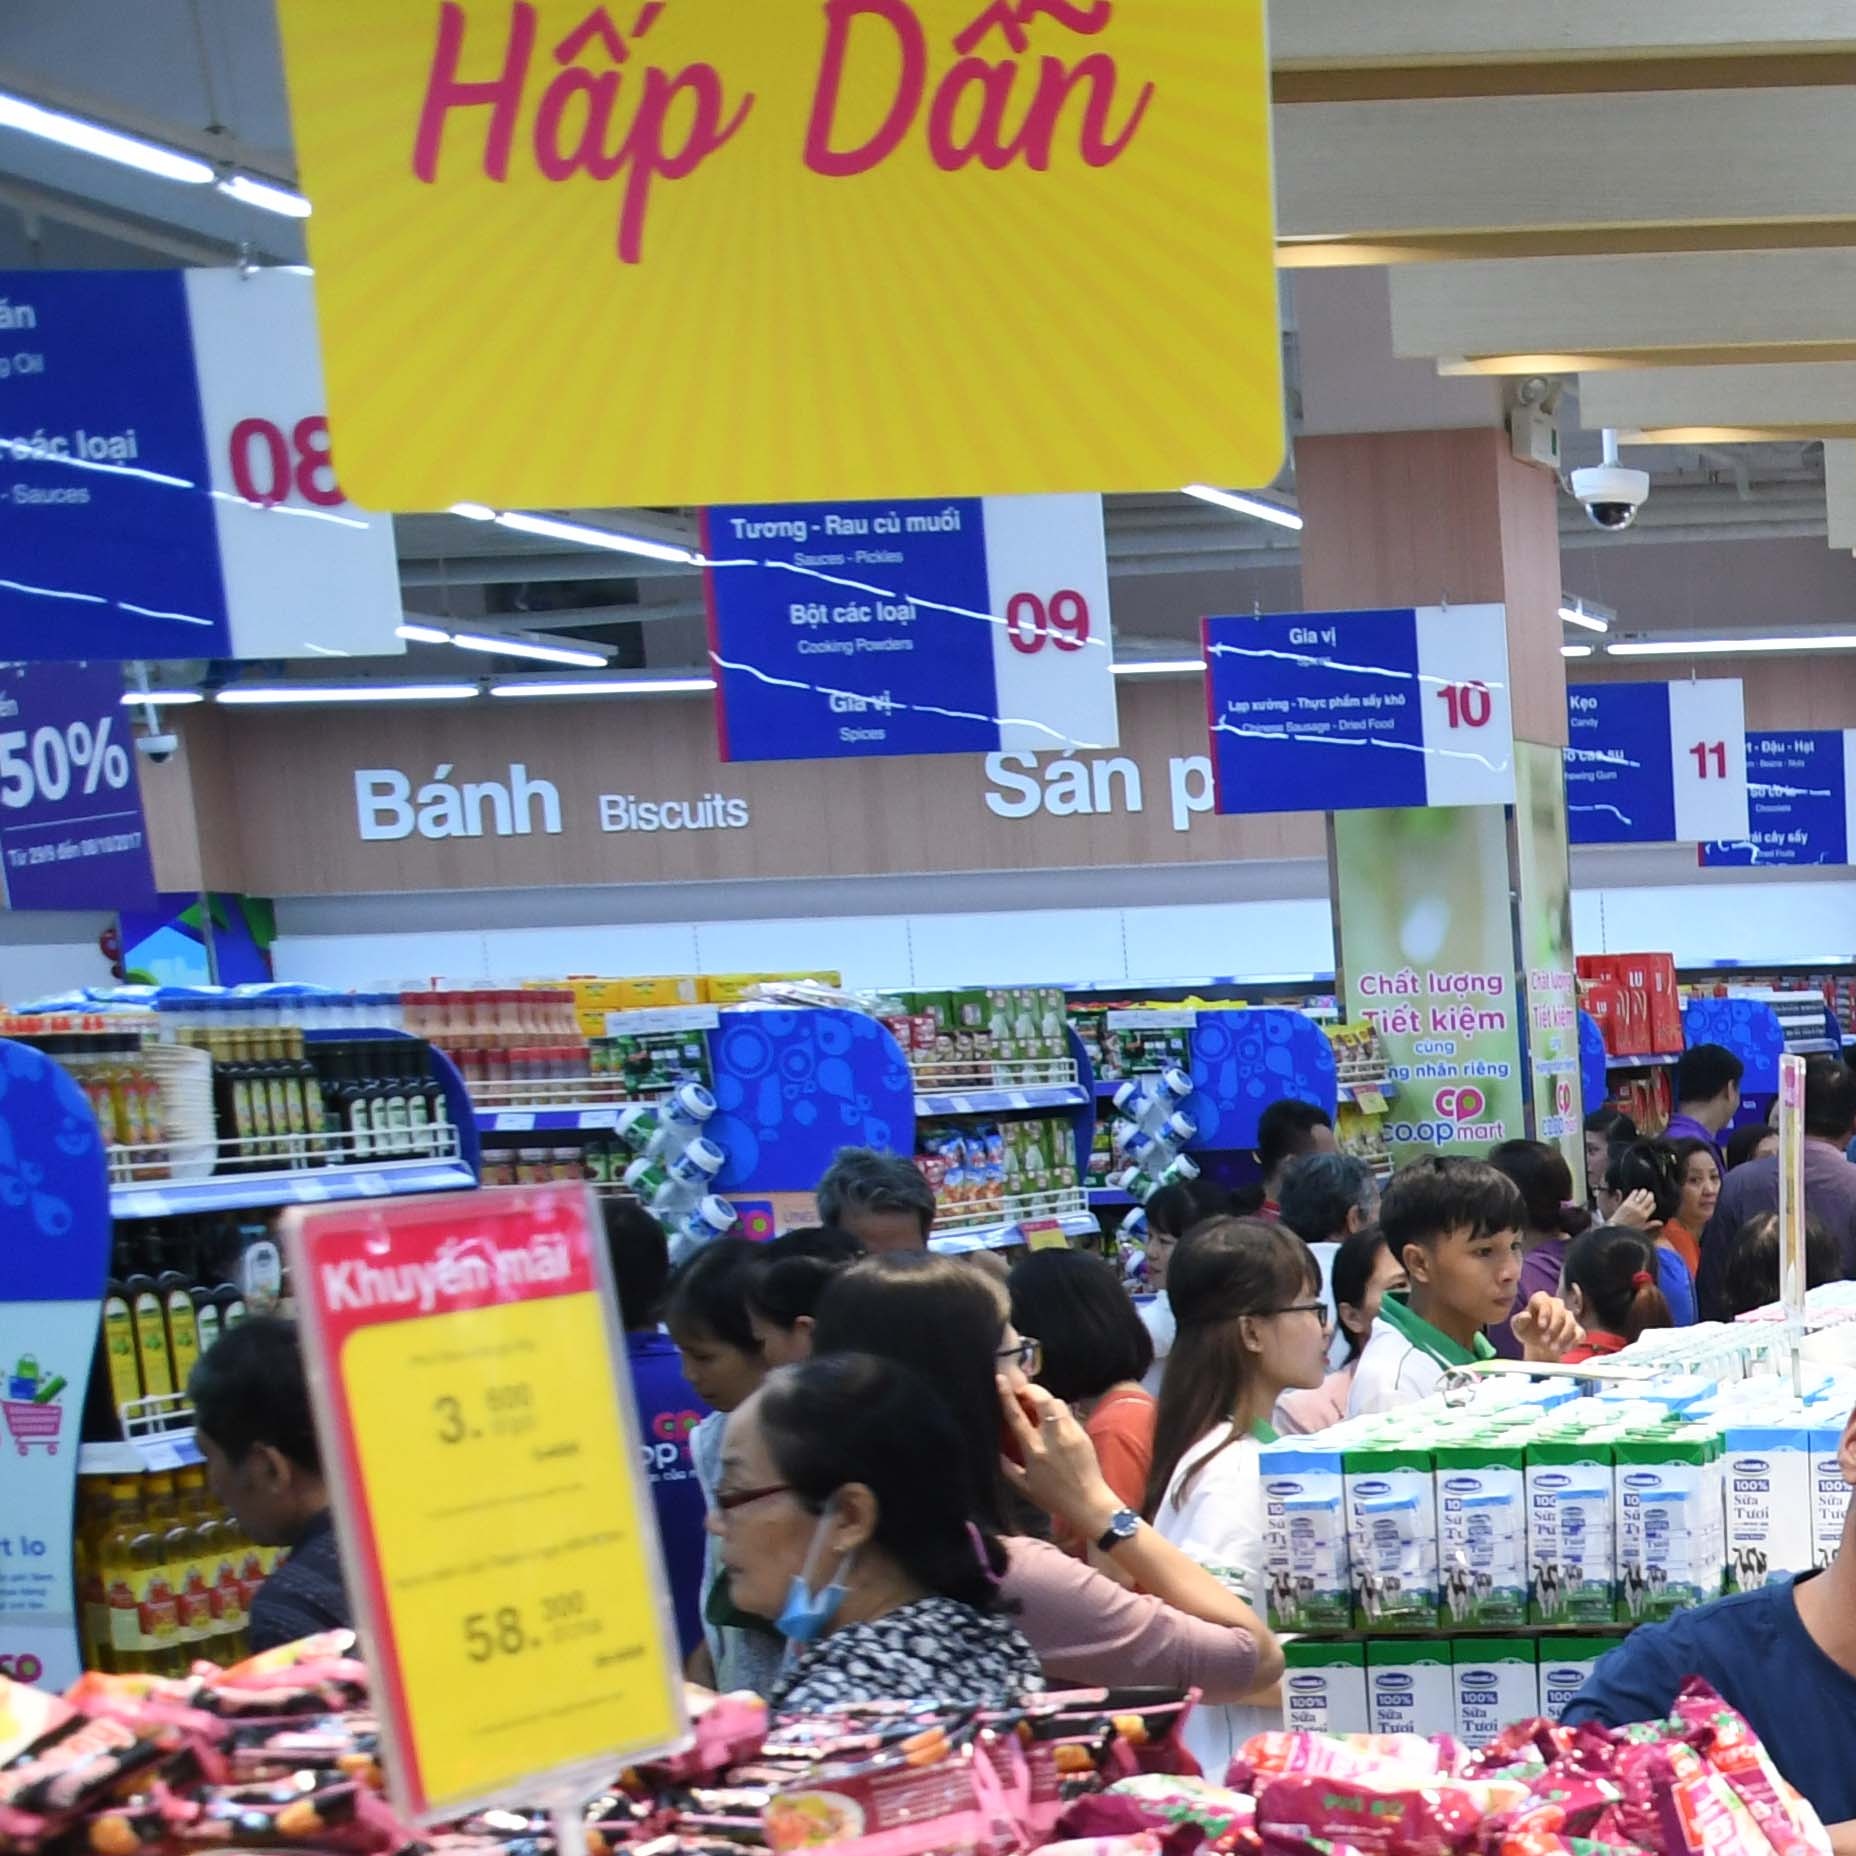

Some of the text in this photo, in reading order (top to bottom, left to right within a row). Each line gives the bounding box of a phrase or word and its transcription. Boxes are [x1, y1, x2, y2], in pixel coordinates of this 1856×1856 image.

[411, 0, 1155, 264] Hấp Dẫn
[76, 429, 138, 467] loại
[229, 415, 348, 508] 08
[730, 518, 807, 542] Tương
[825, 514, 868, 536] Rau
[873, 511, 900, 535] củ
[906, 507, 961, 532] muối
[794, 549, 904, 567] Sauces Pickles
[789, 599, 917, 629] Bột các loại
[1006, 589, 1090, 654] 09
[797, 637, 914, 656] Cooking Powders
[1289, 627, 1337, 648] Gia vị
[1436, 679, 1492, 729] 10
[839, 727, 886, 744] Spices
[1368, 718, 1395, 730] Food
[0, 717, 129, 808] 50%
[1689, 741, 1727, 779] 11
[1564, 771, 1594, 782] hewing
[351, 764, 750, 842] Bánh Biscuits
[1360, 969, 1503, 1000] Chất lượng
[1362, 1006, 1505, 1043] Tiết kiệm
[1415, 1039, 1455, 1057] cùng
[1388, 1067, 1411, 1081] ng
[1463, 1060, 1509, 1079] riêng
[323, 1236, 490, 1312] Khuyến
[1734, 1494, 1759, 1508] Sữa
[1736, 1481, 1769, 1492] 100%
[1733, 1507, 1769, 1521] Tươi
[1462, 1719, 1499, 1732] Tươi
